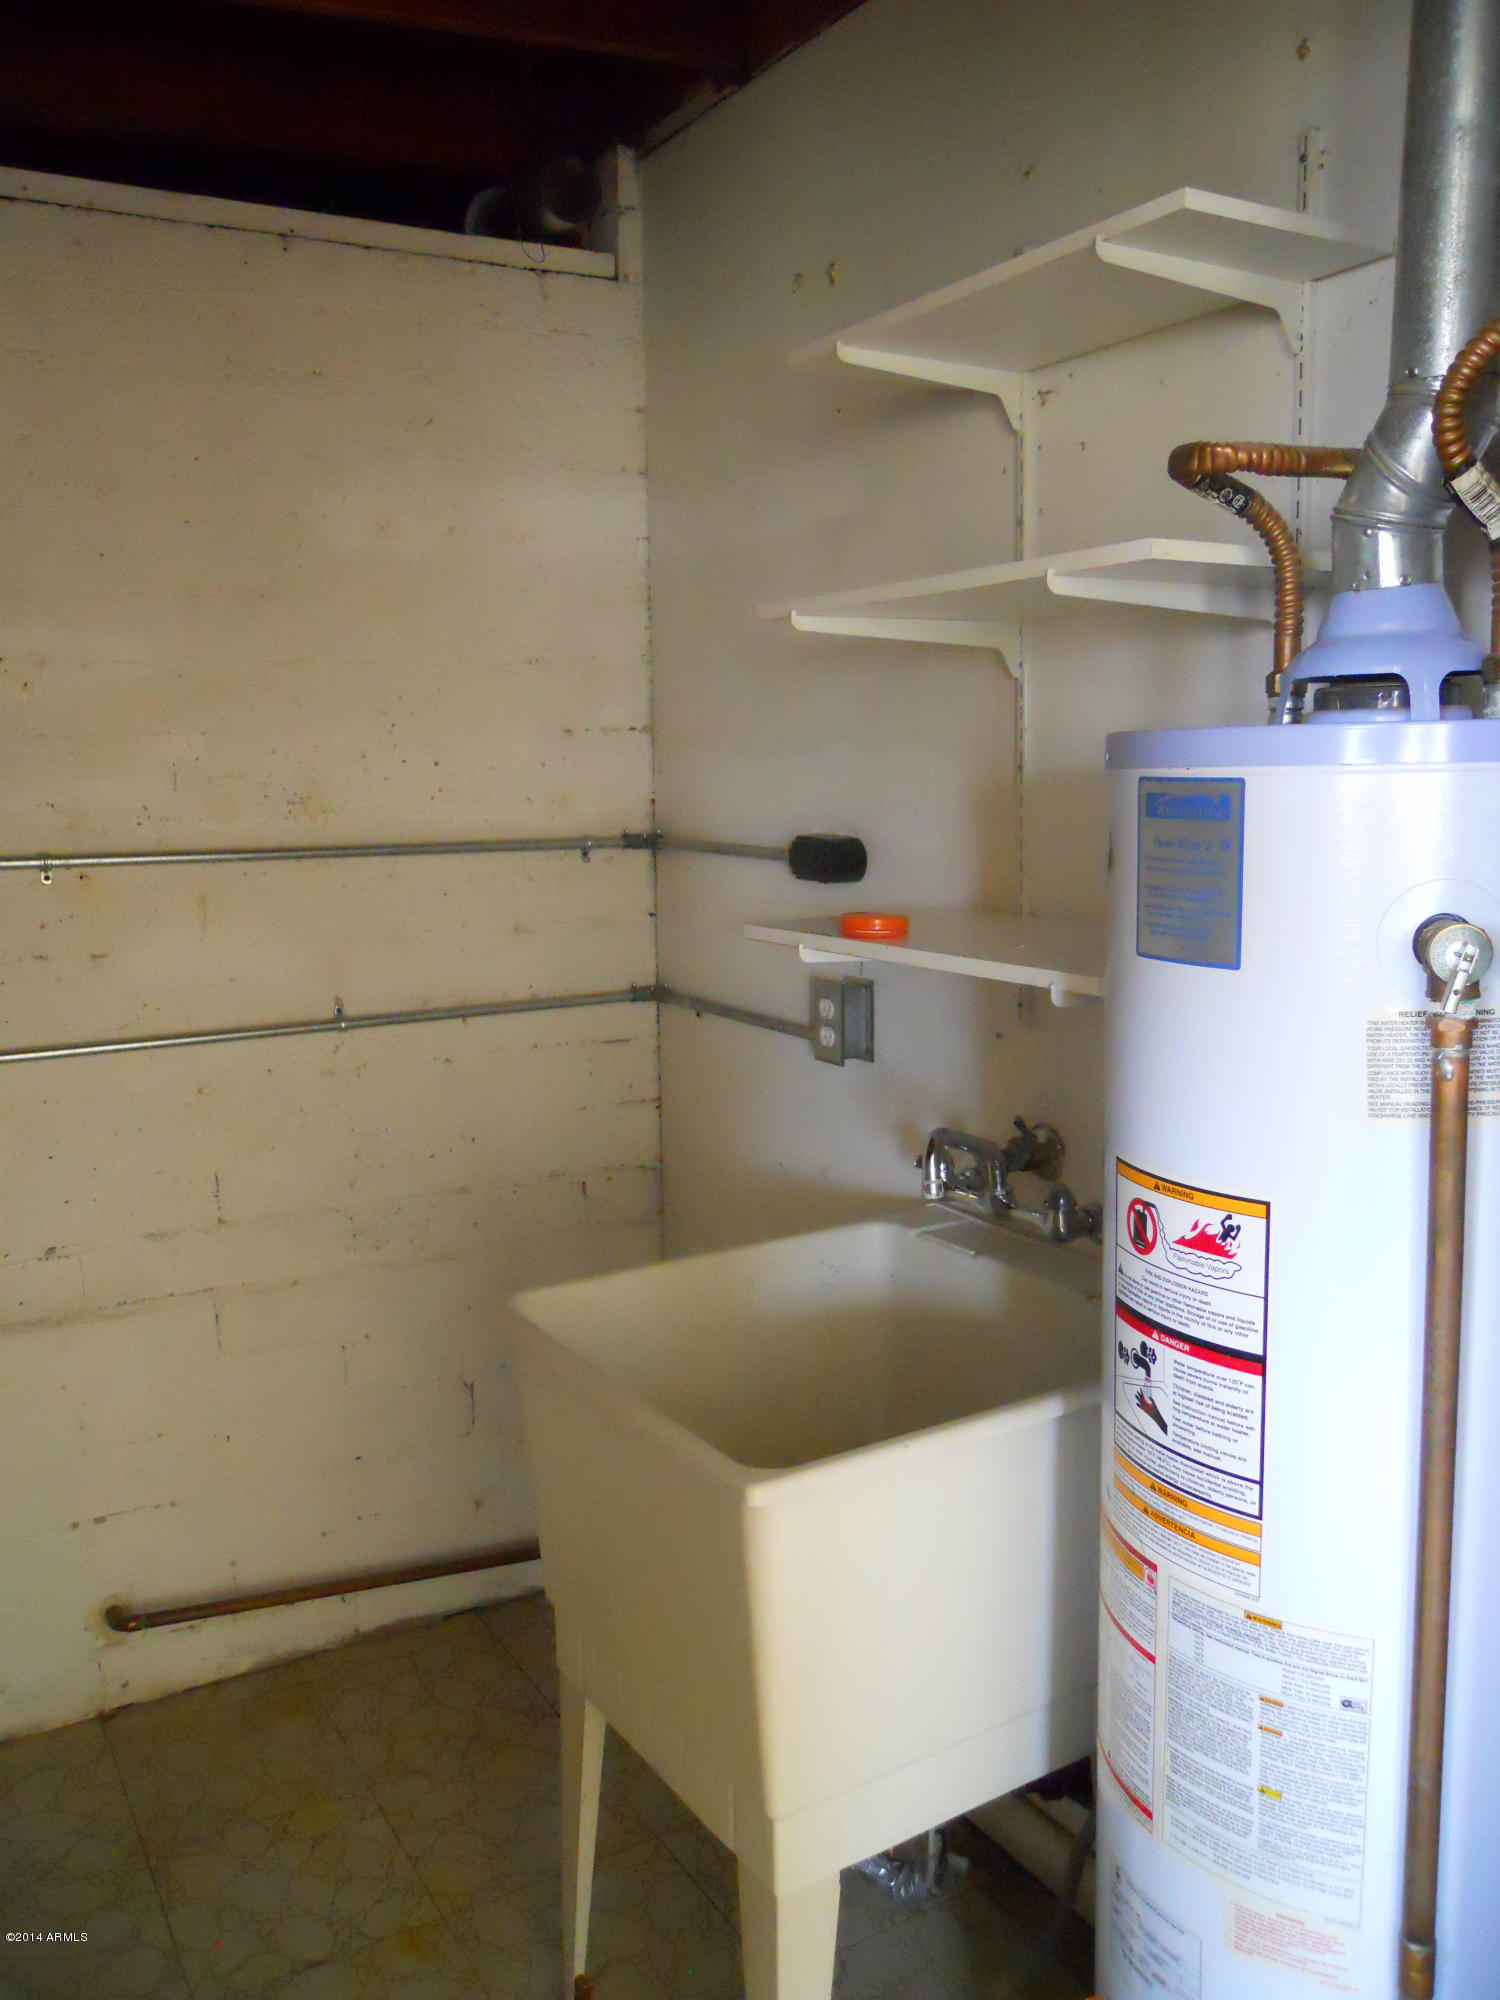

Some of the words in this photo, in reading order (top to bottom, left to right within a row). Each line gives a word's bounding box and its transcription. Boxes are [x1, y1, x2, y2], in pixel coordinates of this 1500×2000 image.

[1161, 1185, 1194, 1200] WARNING
[1173, 1253, 1205, 1268] Flammable
[1206, 1263, 1230, 1275] Vapors
[1188, 1286, 1208, 1297] HAZARD
[1160, 1335, 1190, 1352] DANGER
[1157, 1486, 1187, 1507] WARNING
[1150, 1510, 1195, 1539] ADVERTENCIA
